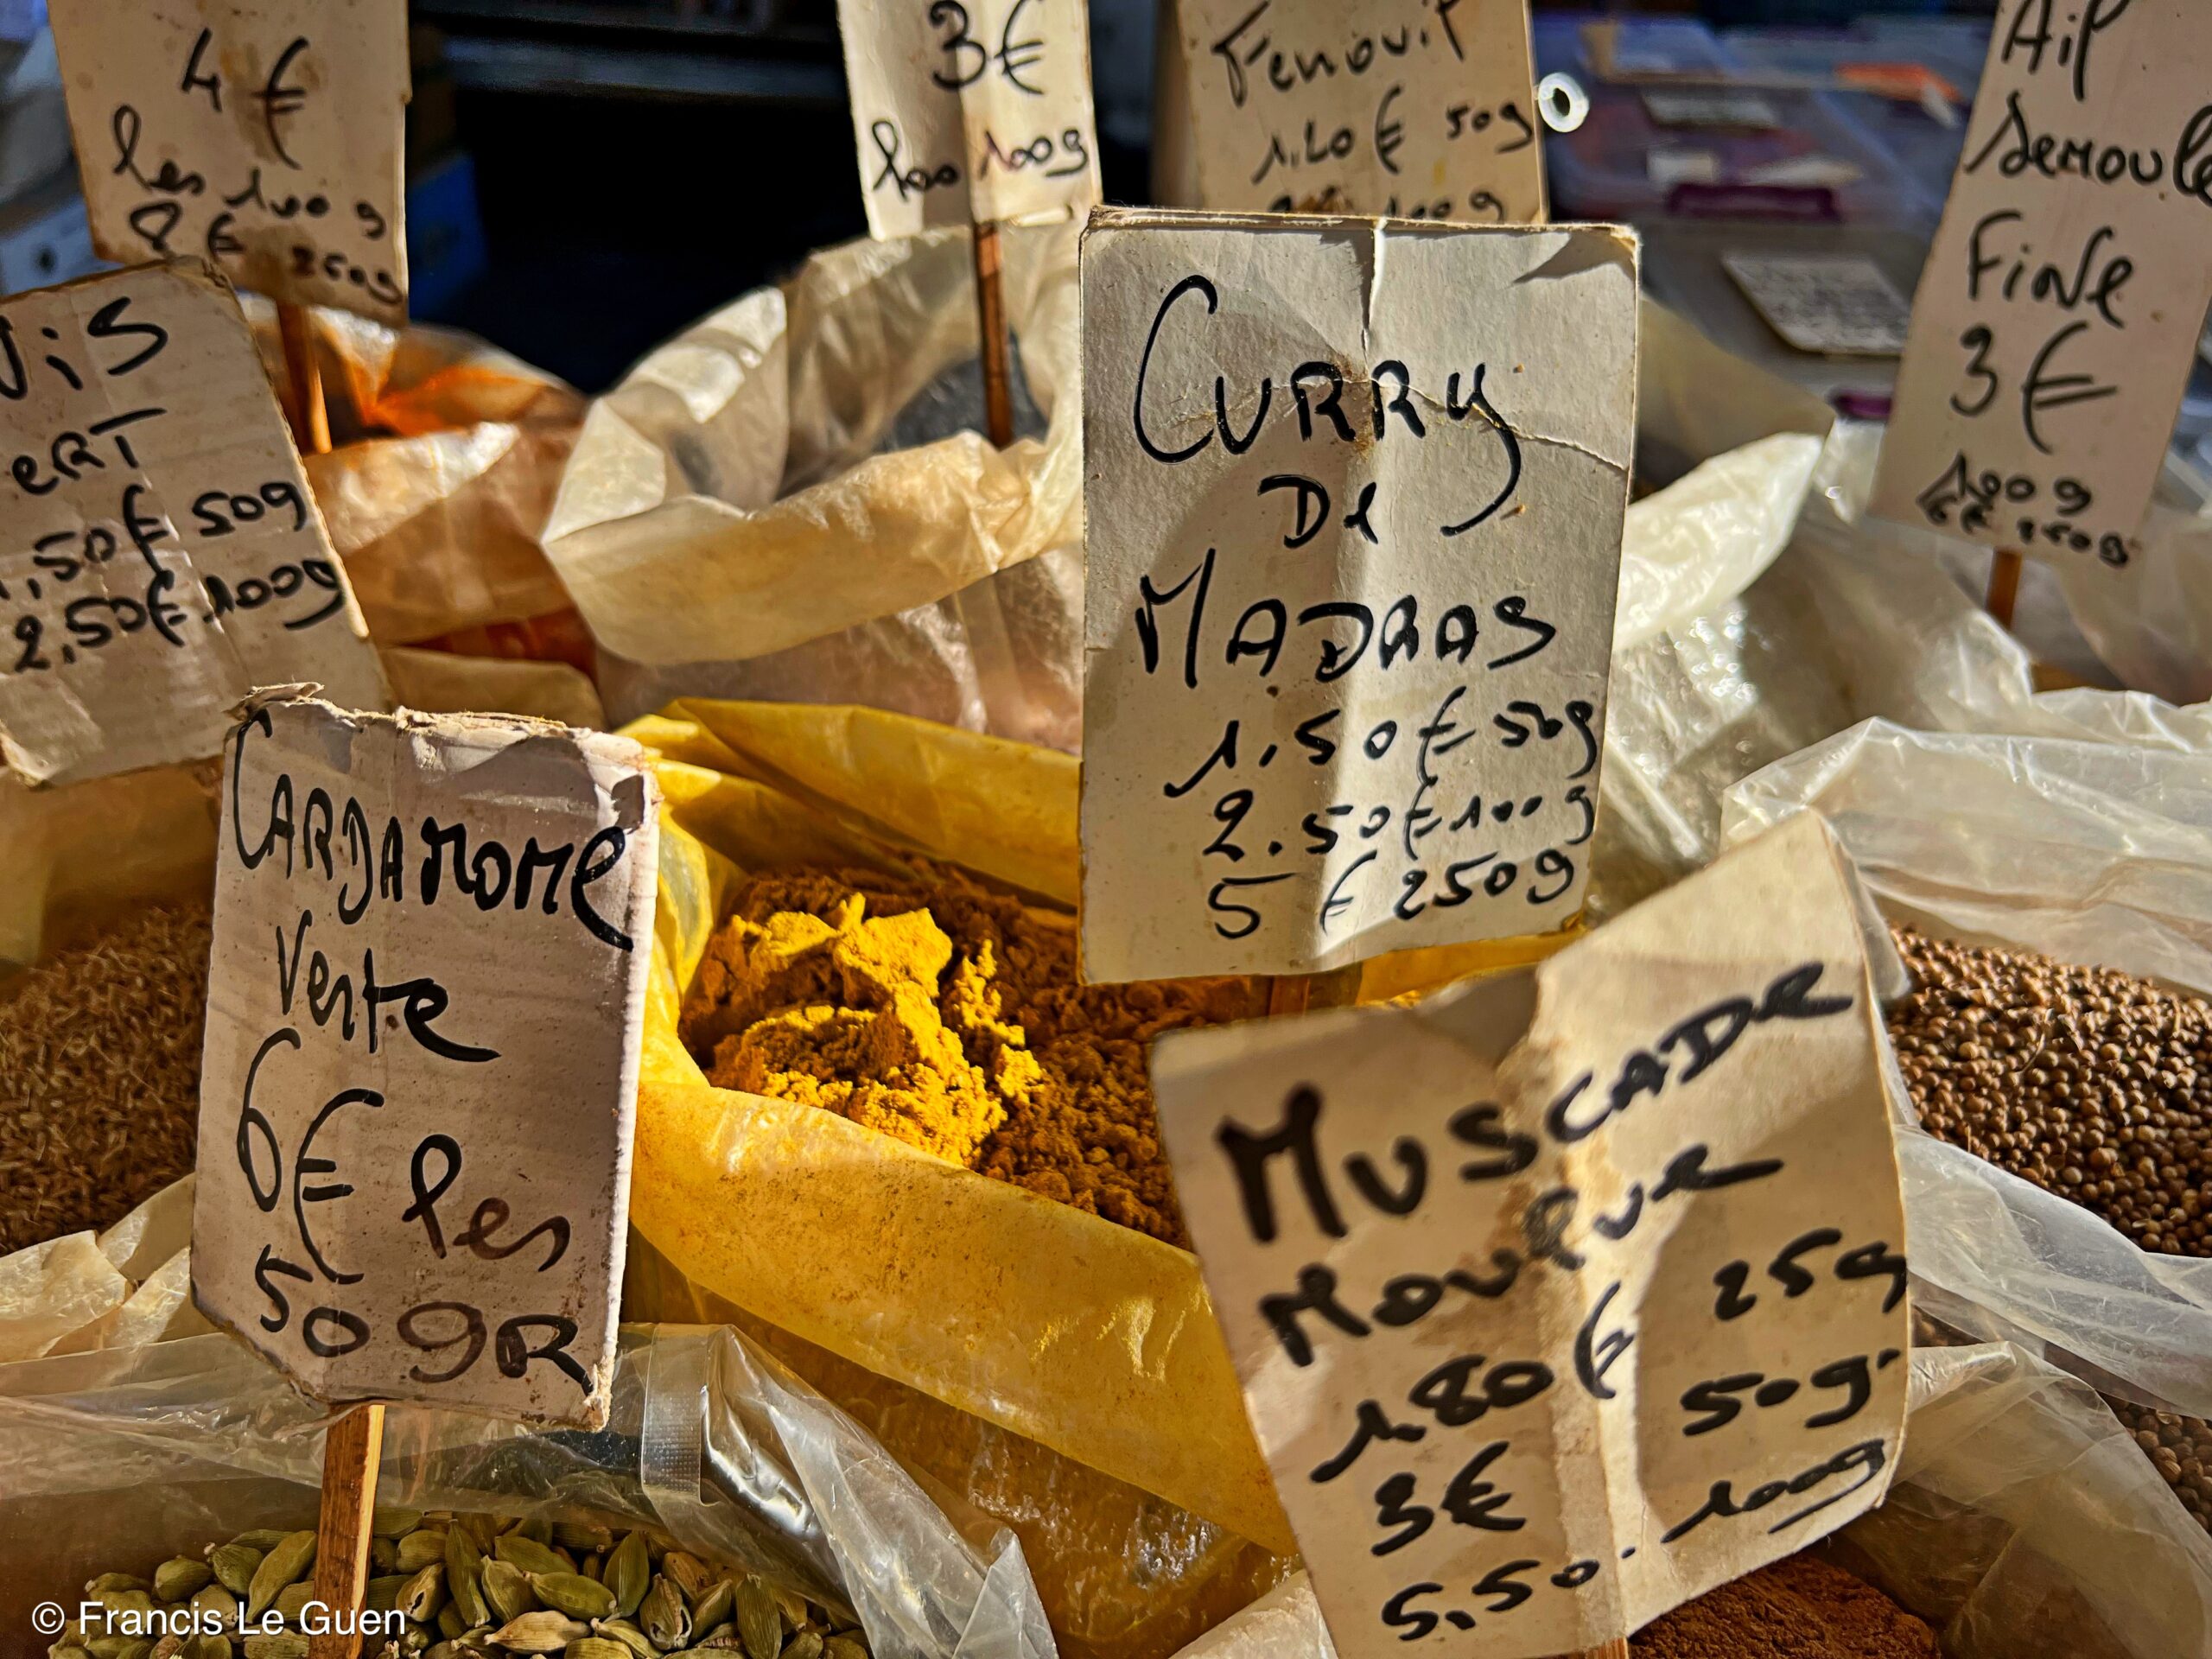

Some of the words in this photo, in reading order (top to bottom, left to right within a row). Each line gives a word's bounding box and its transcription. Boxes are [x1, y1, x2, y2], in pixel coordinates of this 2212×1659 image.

[980, 128, 1089, 181] 100g
[1446, 101, 1534, 155] 50g
[192, 480, 308, 537] 50g
[1393, 848, 1576, 921] 250g
[1370, 1440, 1528, 1557] 3€
